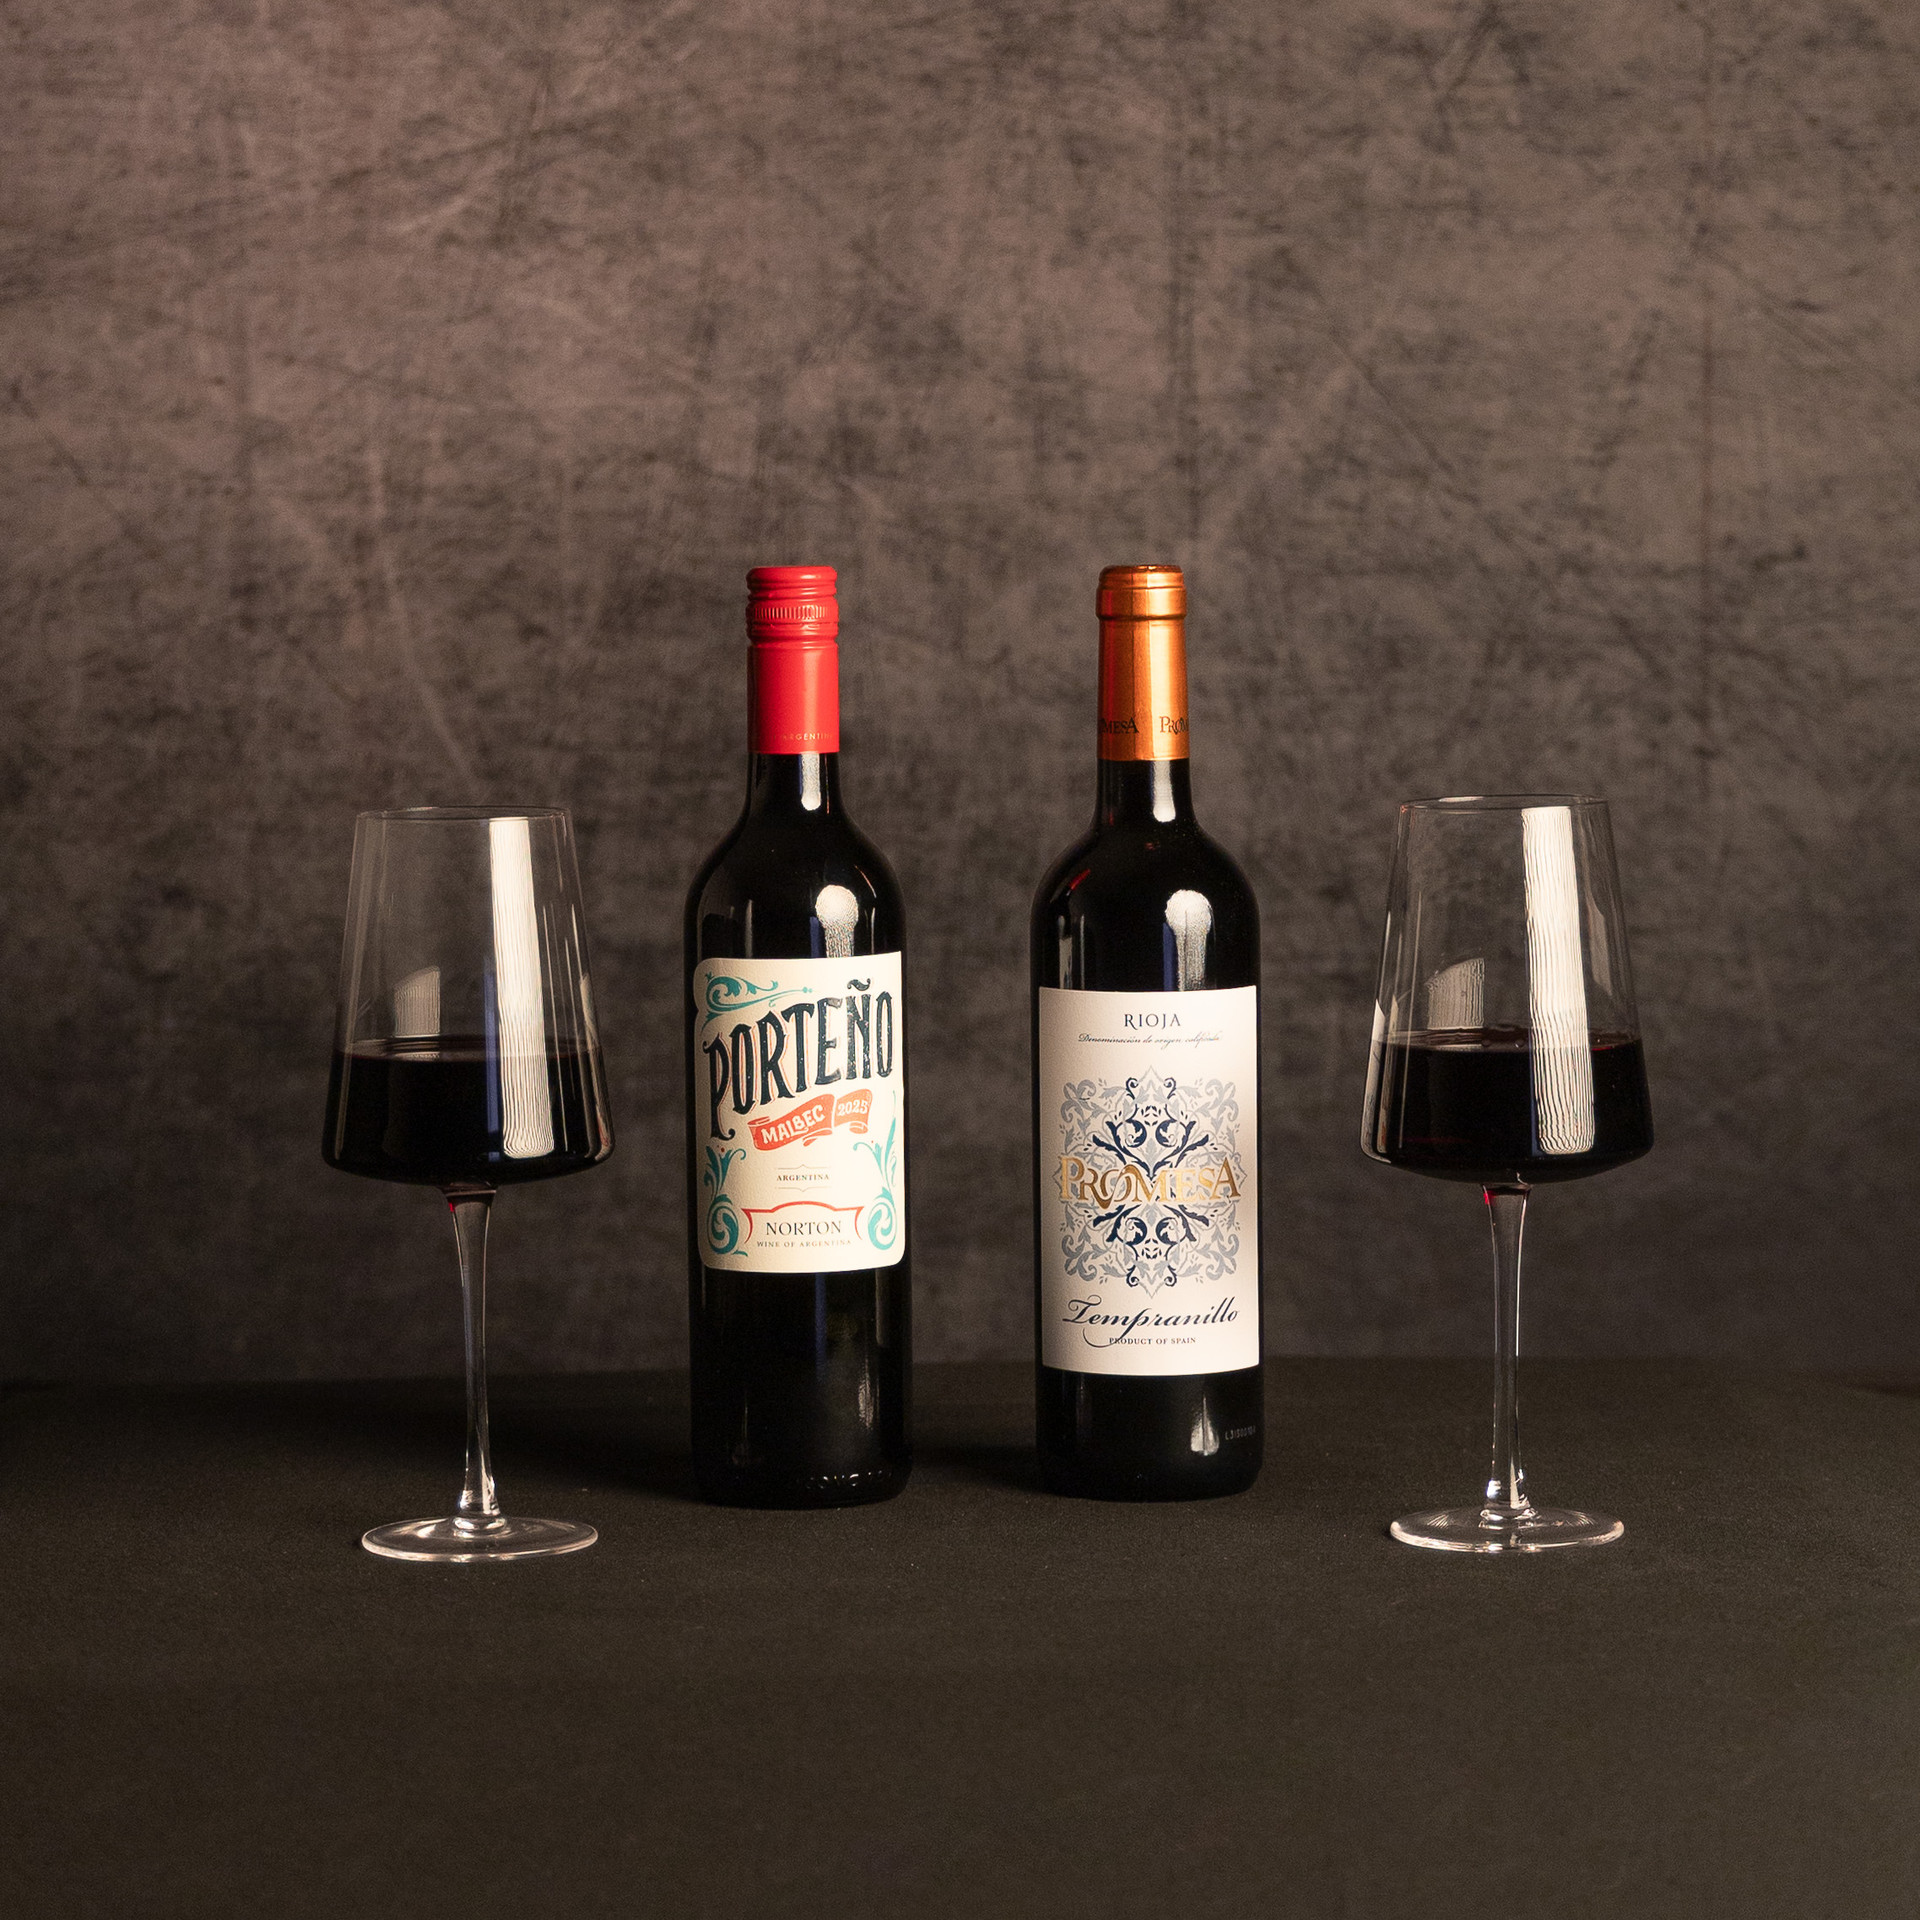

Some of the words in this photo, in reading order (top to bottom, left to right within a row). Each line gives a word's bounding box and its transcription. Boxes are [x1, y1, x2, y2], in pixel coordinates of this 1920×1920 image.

[1123, 1013, 1182, 1030] RIOJA
[703, 978, 893, 1141] PORTEÑO
[760, 1104, 826, 1144] MALBEC
[837, 1099, 869, 1117] 2025
[776, 1174, 830, 1182] ARGENTINA
[1059, 1156, 1242, 1210] PROMESA
[766, 1220, 842, 1236] NORTON
[799, 1240, 852, 1248] ARGENTINA
[1062, 1294, 1240, 1348] Tempranillo
[1109, 1337, 1152, 1346] PRODUCT
[1155, 1338, 1167, 1346] OF
[1170, 1337, 1196, 1346] SPAIN
